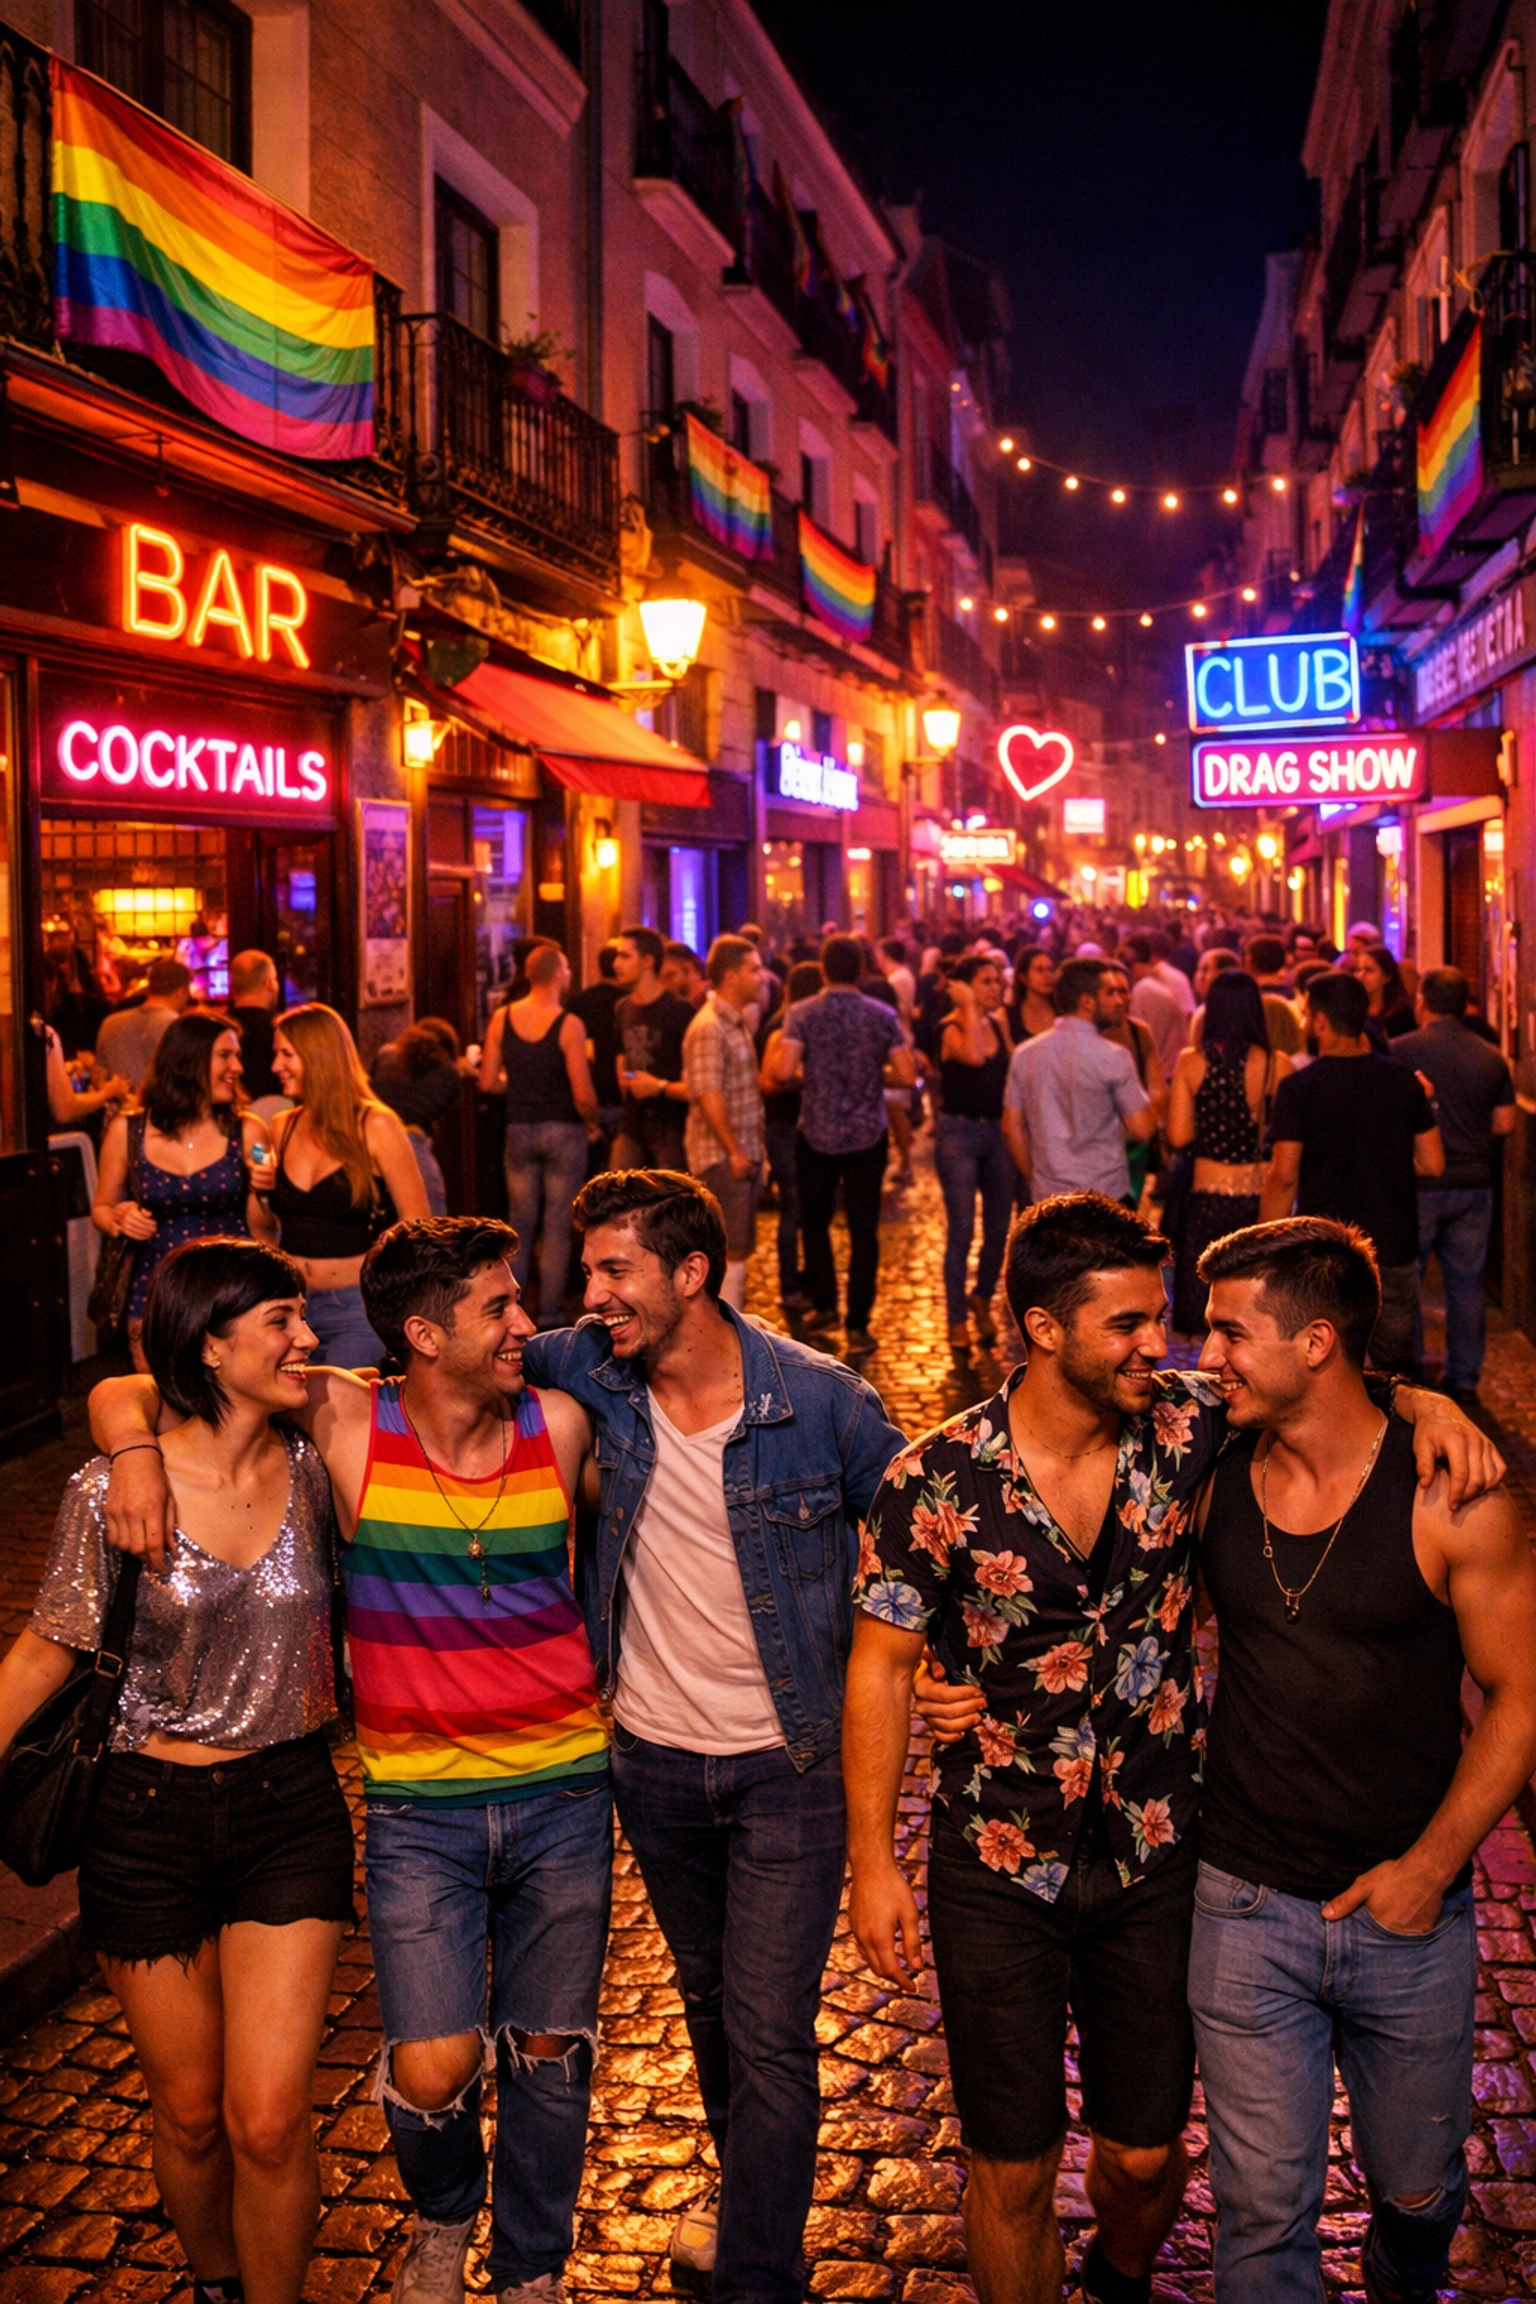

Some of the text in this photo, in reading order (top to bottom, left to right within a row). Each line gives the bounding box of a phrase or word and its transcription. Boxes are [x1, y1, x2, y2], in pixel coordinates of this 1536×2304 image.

[124, 523, 310, 668] BAR
[1197, 649, 1352, 718] CLUB
[59, 721, 328, 801] COCKTAILS
[1204, 748, 1417, 796] DRAG SHOW
